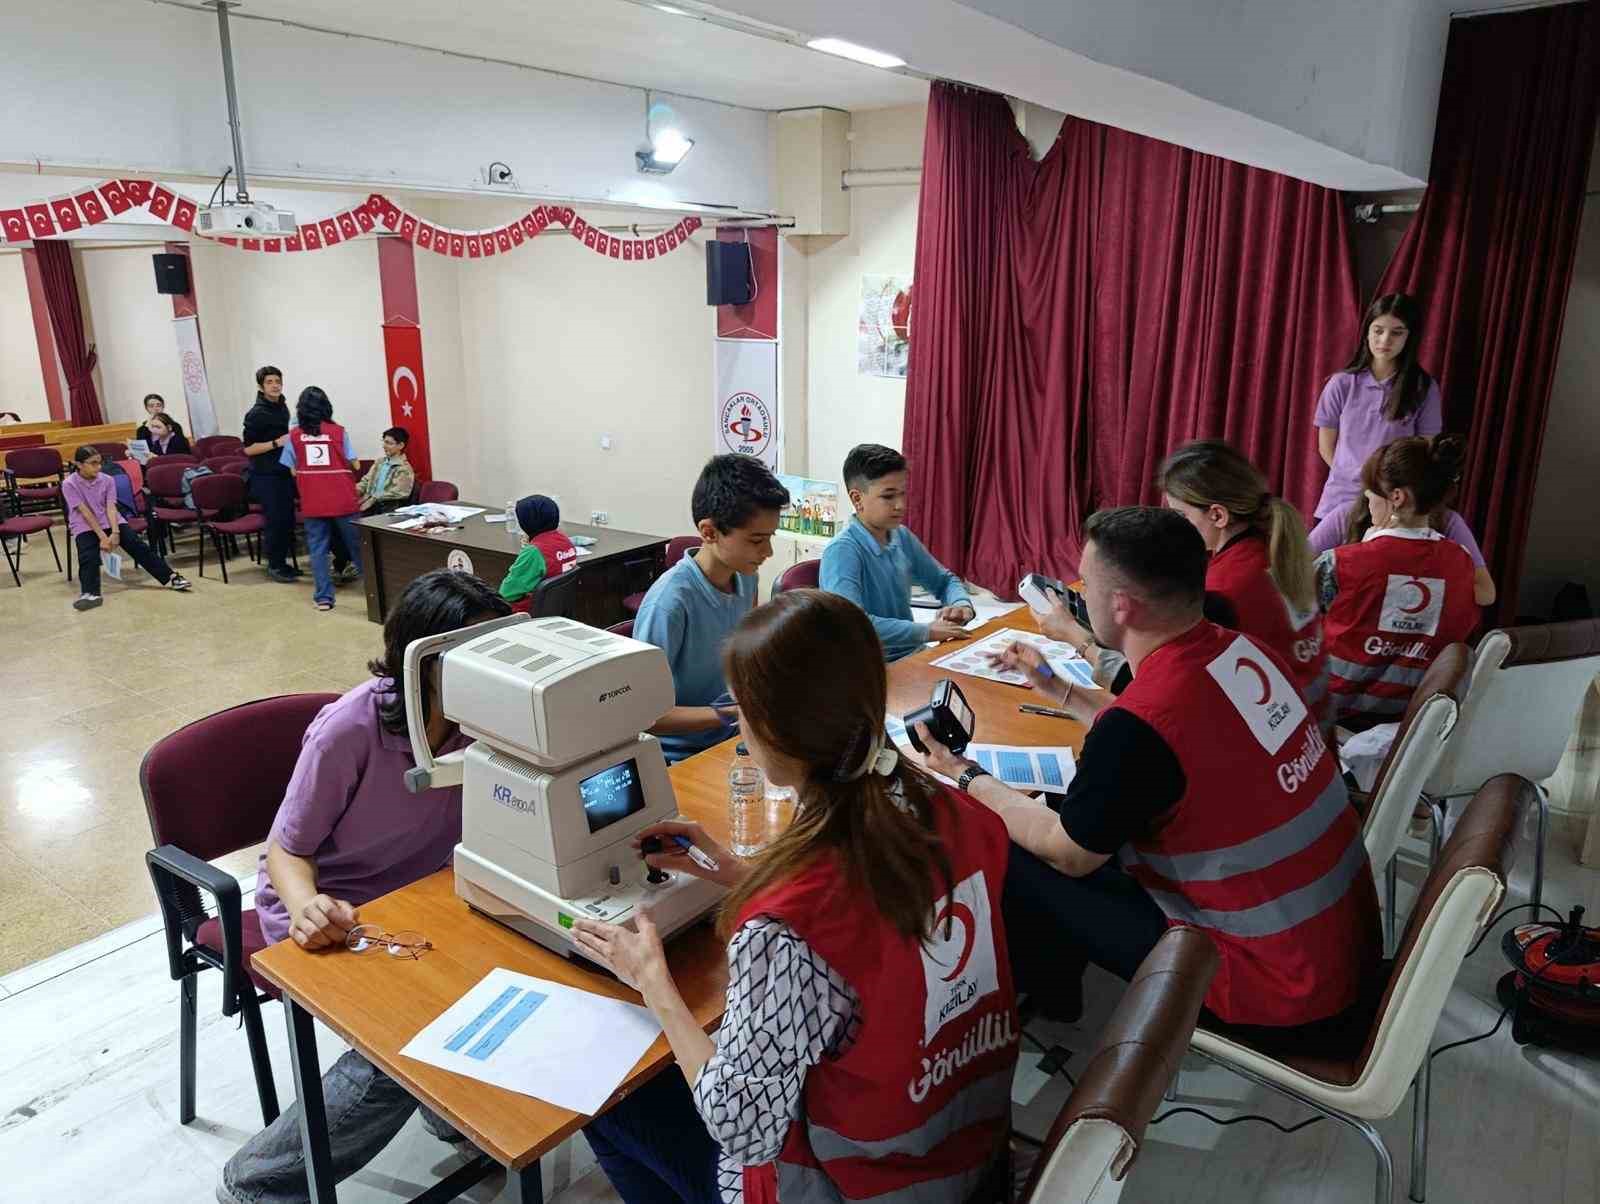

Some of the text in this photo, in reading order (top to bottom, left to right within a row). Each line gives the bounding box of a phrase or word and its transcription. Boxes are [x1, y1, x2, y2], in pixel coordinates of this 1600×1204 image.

[723, 396, 768, 438] SANCAKLAR ORTAOKULU
[738, 444, 754, 453] 2005
[938, 977, 978, 1023] KIZILAY
[908, 1009, 1018, 1103] Gönüllü
